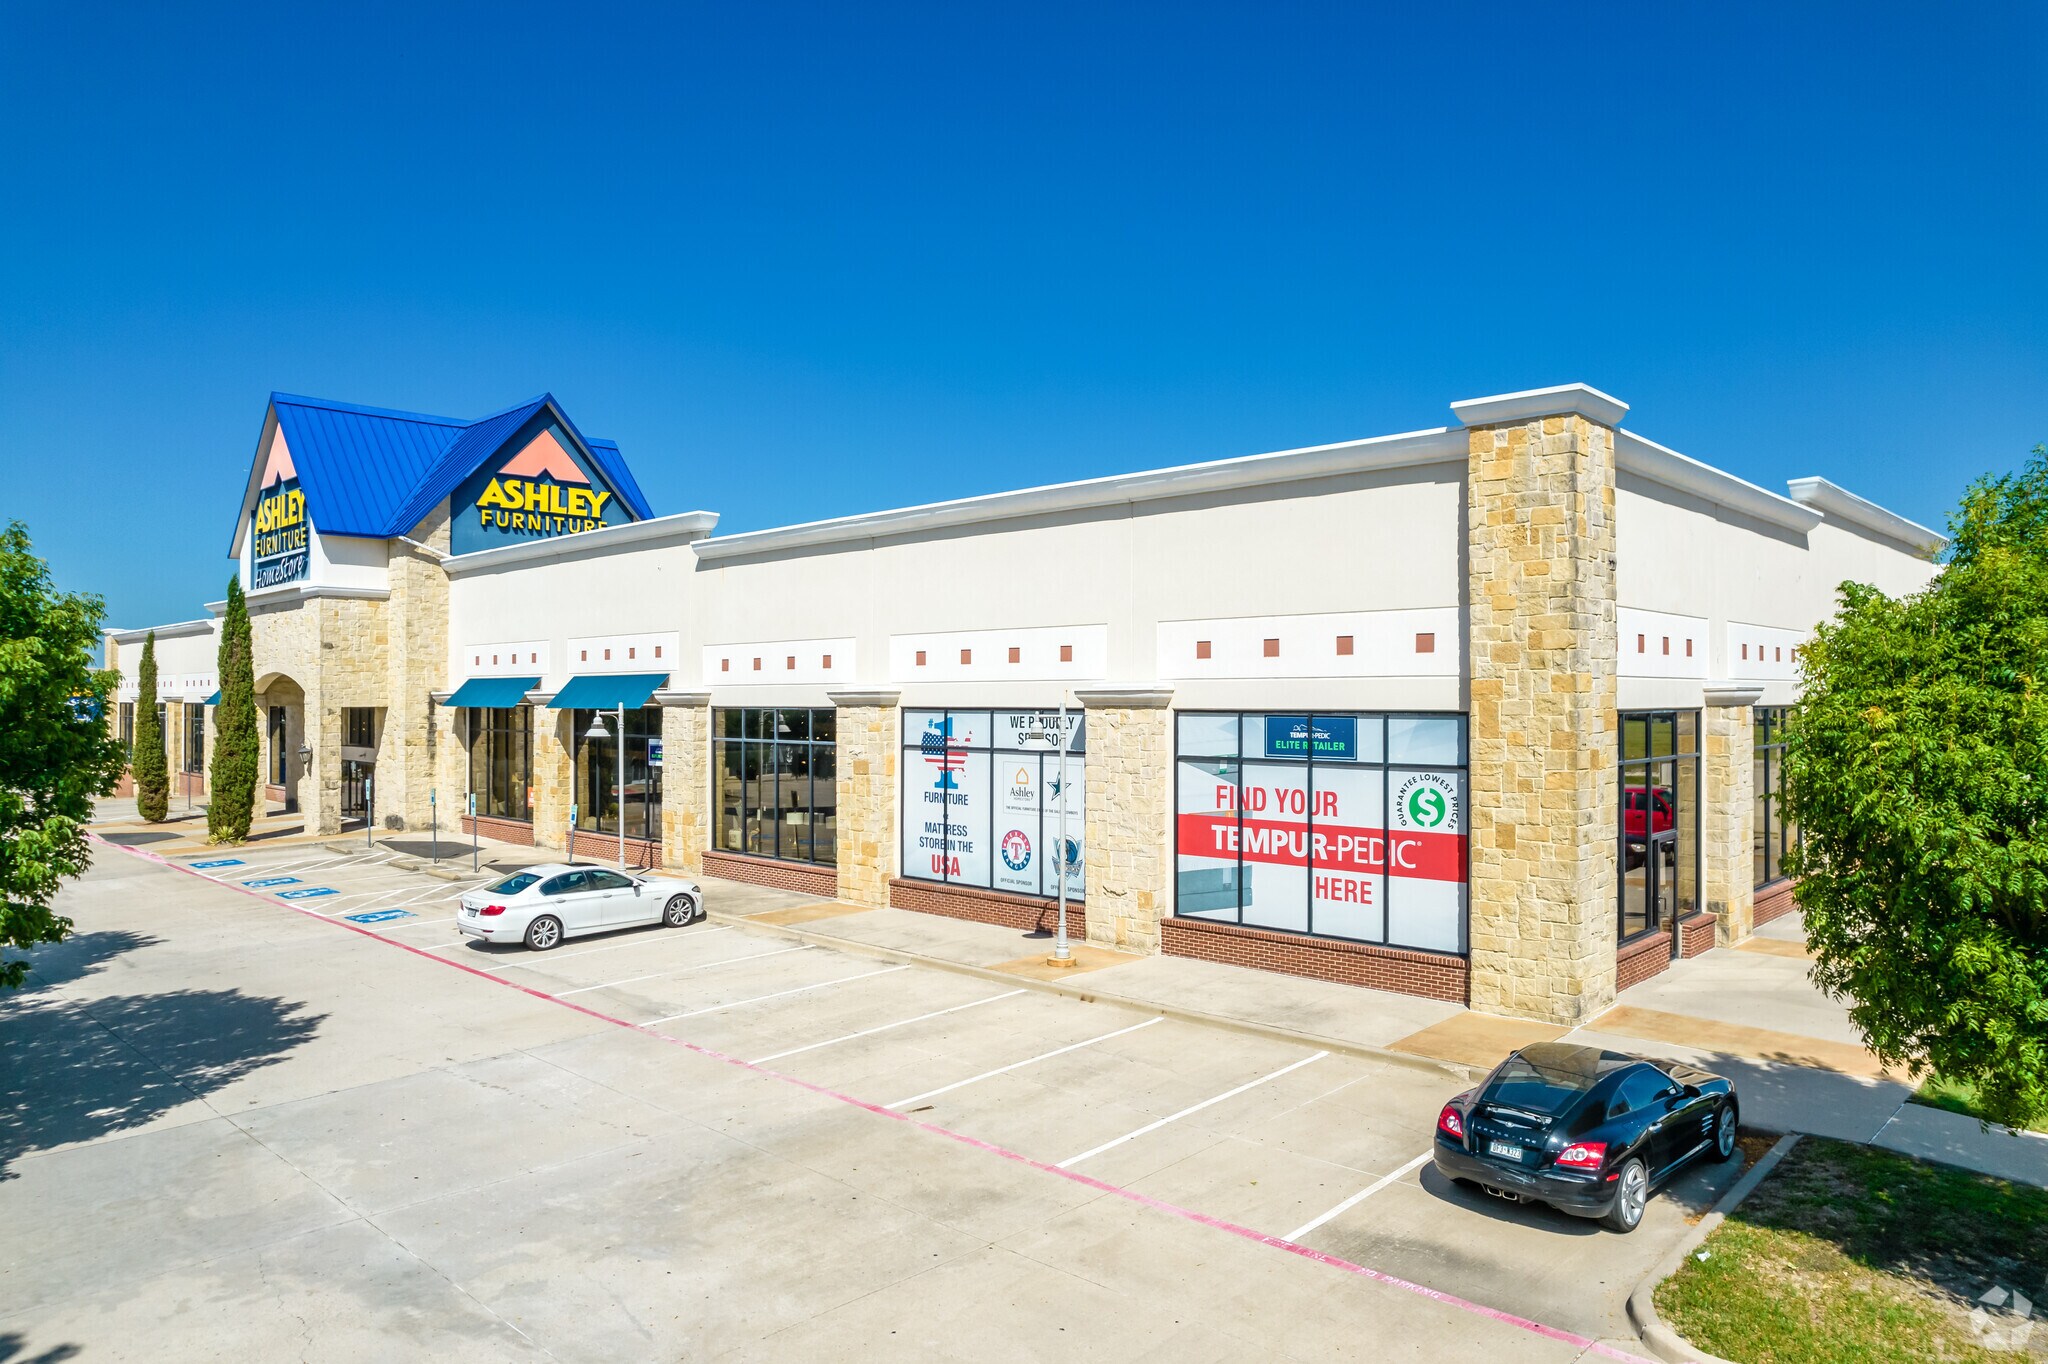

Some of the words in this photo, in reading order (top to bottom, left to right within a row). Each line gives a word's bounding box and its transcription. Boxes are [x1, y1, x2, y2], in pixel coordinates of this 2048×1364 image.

[476, 477, 611, 518] ASHLEY
[254, 489, 305, 535] ASHLEY
[255, 527, 306, 558] FURNITURE
[1010, 715, 1025, 729] WE
[1028, 715, 1075, 730] POUDY
[1275, 740, 1300, 749] ELITE
[1302, 741, 1345, 751] RTAILER
[924, 791, 969, 806] FURNTURE
[1010, 786, 1035, 800] Ashley
[1216, 785, 1267, 812] FIND
[1275, 788, 1338, 818] YOUR
[1396, 776, 1418, 827] GUARANTEE
[1419, 773, 1454, 794] LOWEST
[1447, 796, 1459, 830] PRICES
[924, 821, 968, 837] MATTRESS
[1005, 831, 1028, 843] TEXAS
[919, 836, 945, 850] STORE
[947, 839, 956, 851] IN
[957, 840, 974, 853] THE
[1211, 824, 1417, 869] TEMPUR-PEDIC
[931, 854, 961, 877] USA
[1002, 851, 1030, 870] RANGERS
[1315, 876, 1373, 905] HERE
[1358, 1267, 1378, 1278] NO
[1382, 1275, 1442, 1299] PARKING
